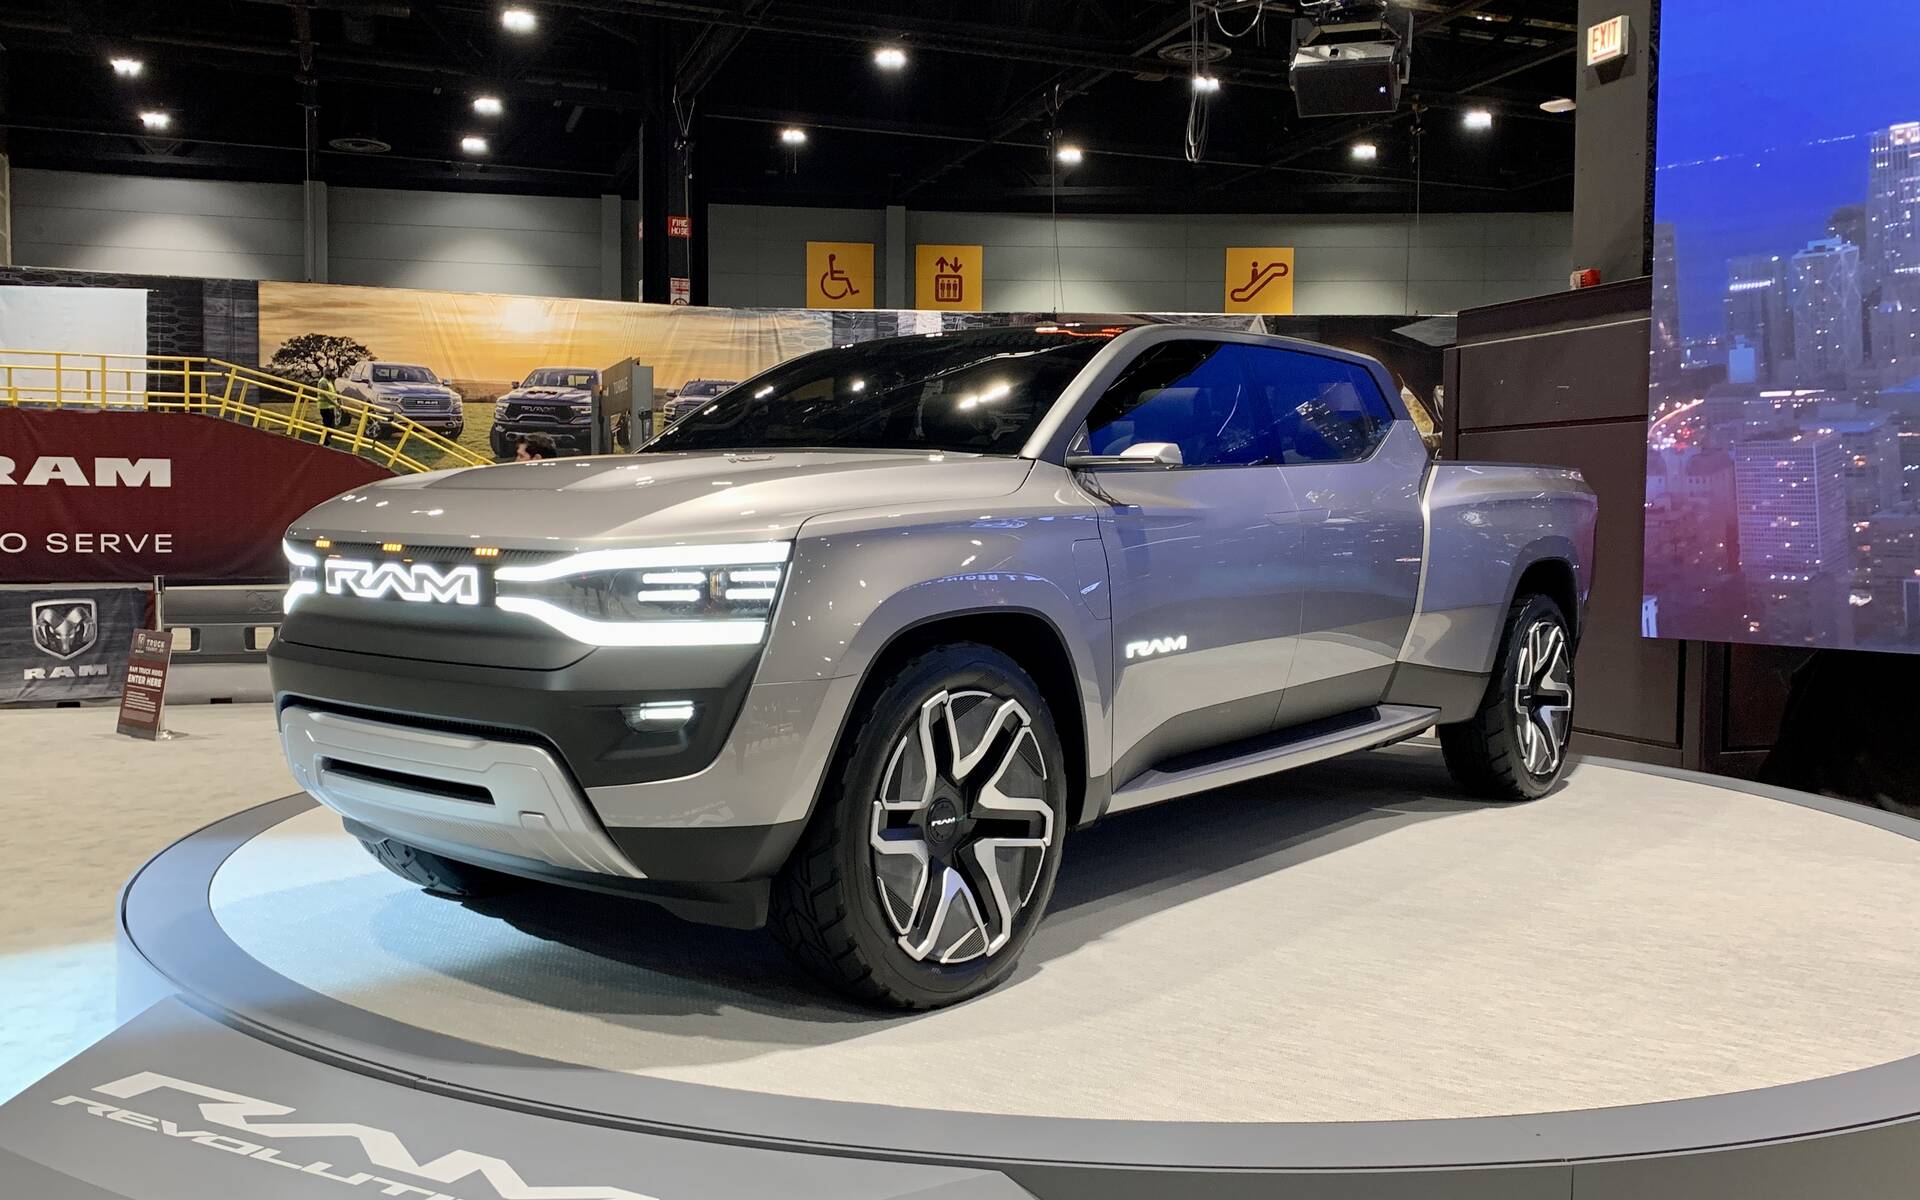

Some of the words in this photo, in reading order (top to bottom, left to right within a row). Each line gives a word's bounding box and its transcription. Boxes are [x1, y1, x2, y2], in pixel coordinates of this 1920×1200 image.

[1592, 20, 1618, 54] EXIT
[671, 218, 688, 227] FIRE
[671, 226, 689, 235] HOSE
[46, 532, 173, 553] SERVE
[325, 558, 480, 605] RAM
[1125, 634, 1189, 660] RAM
[23, 663, 108, 680] RAM
[127, 673, 147, 685] ENTER
[146, 676, 163, 688] HERE
[52, 1095, 463, 1200] REVOLUTI
